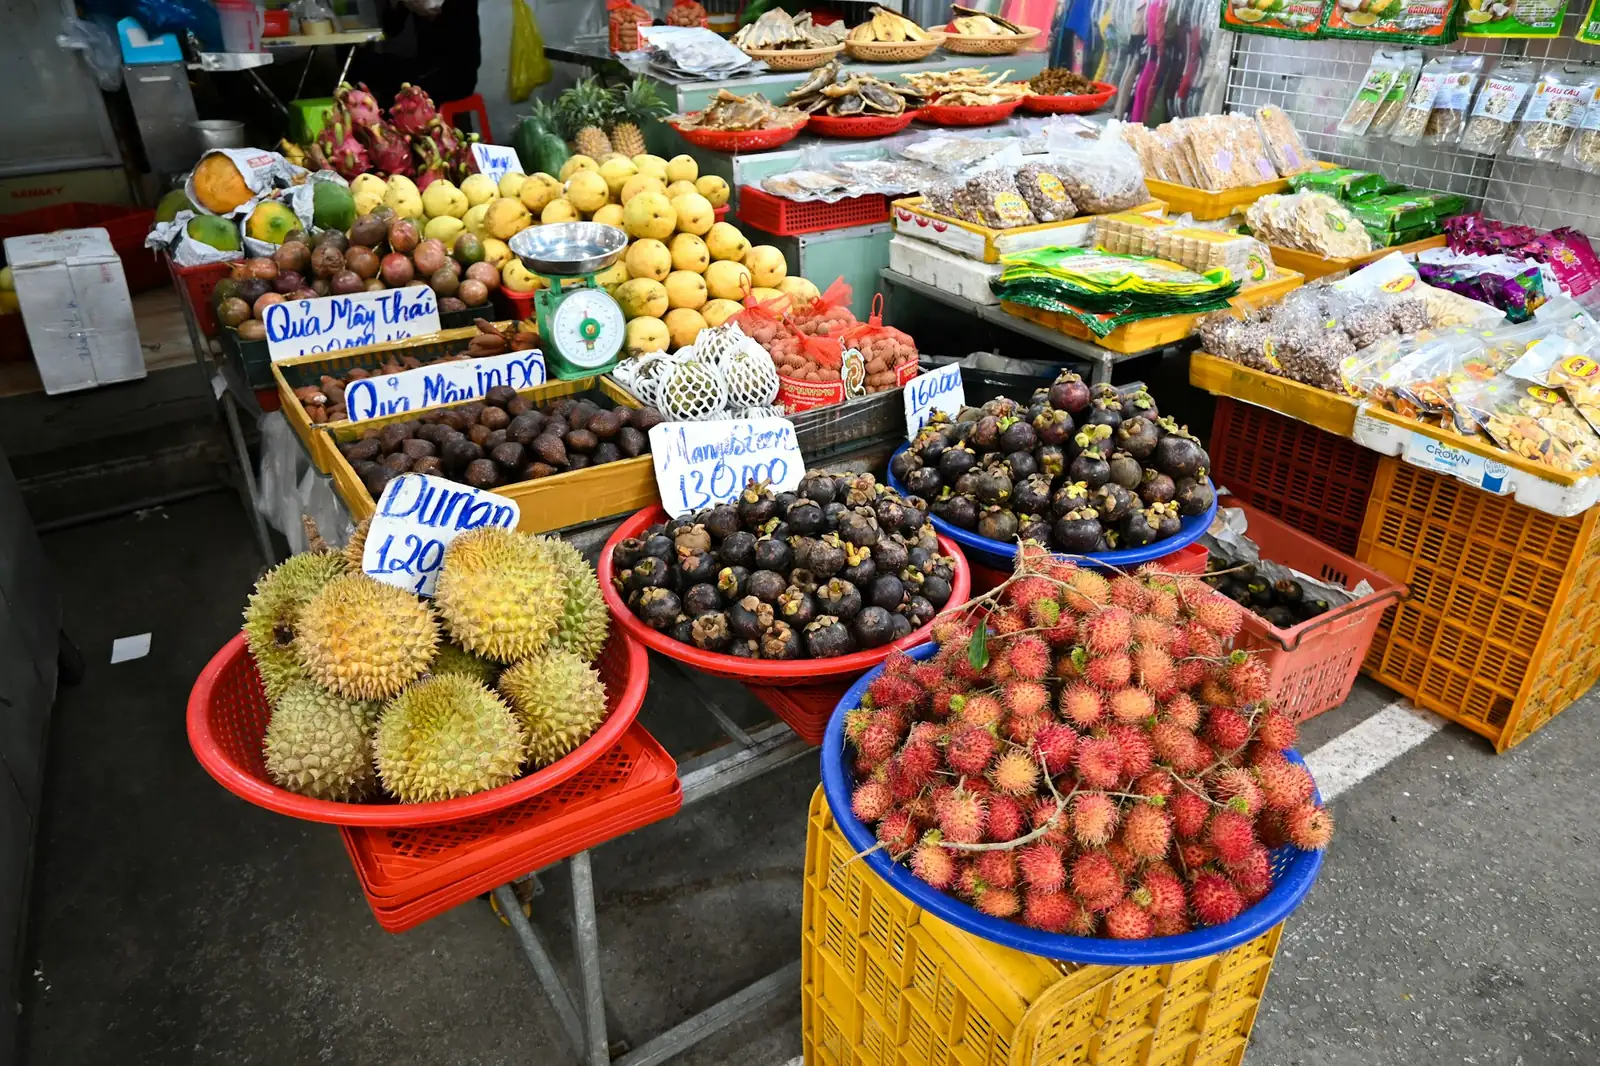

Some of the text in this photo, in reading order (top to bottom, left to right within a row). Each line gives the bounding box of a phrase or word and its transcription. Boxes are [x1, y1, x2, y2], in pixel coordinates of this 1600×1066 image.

[323, 298, 376, 336] Mây
[375, 288, 437, 324] Thái
[1425, 444, 1471, 466] CROWN
[378, 473, 515, 531] Durian
